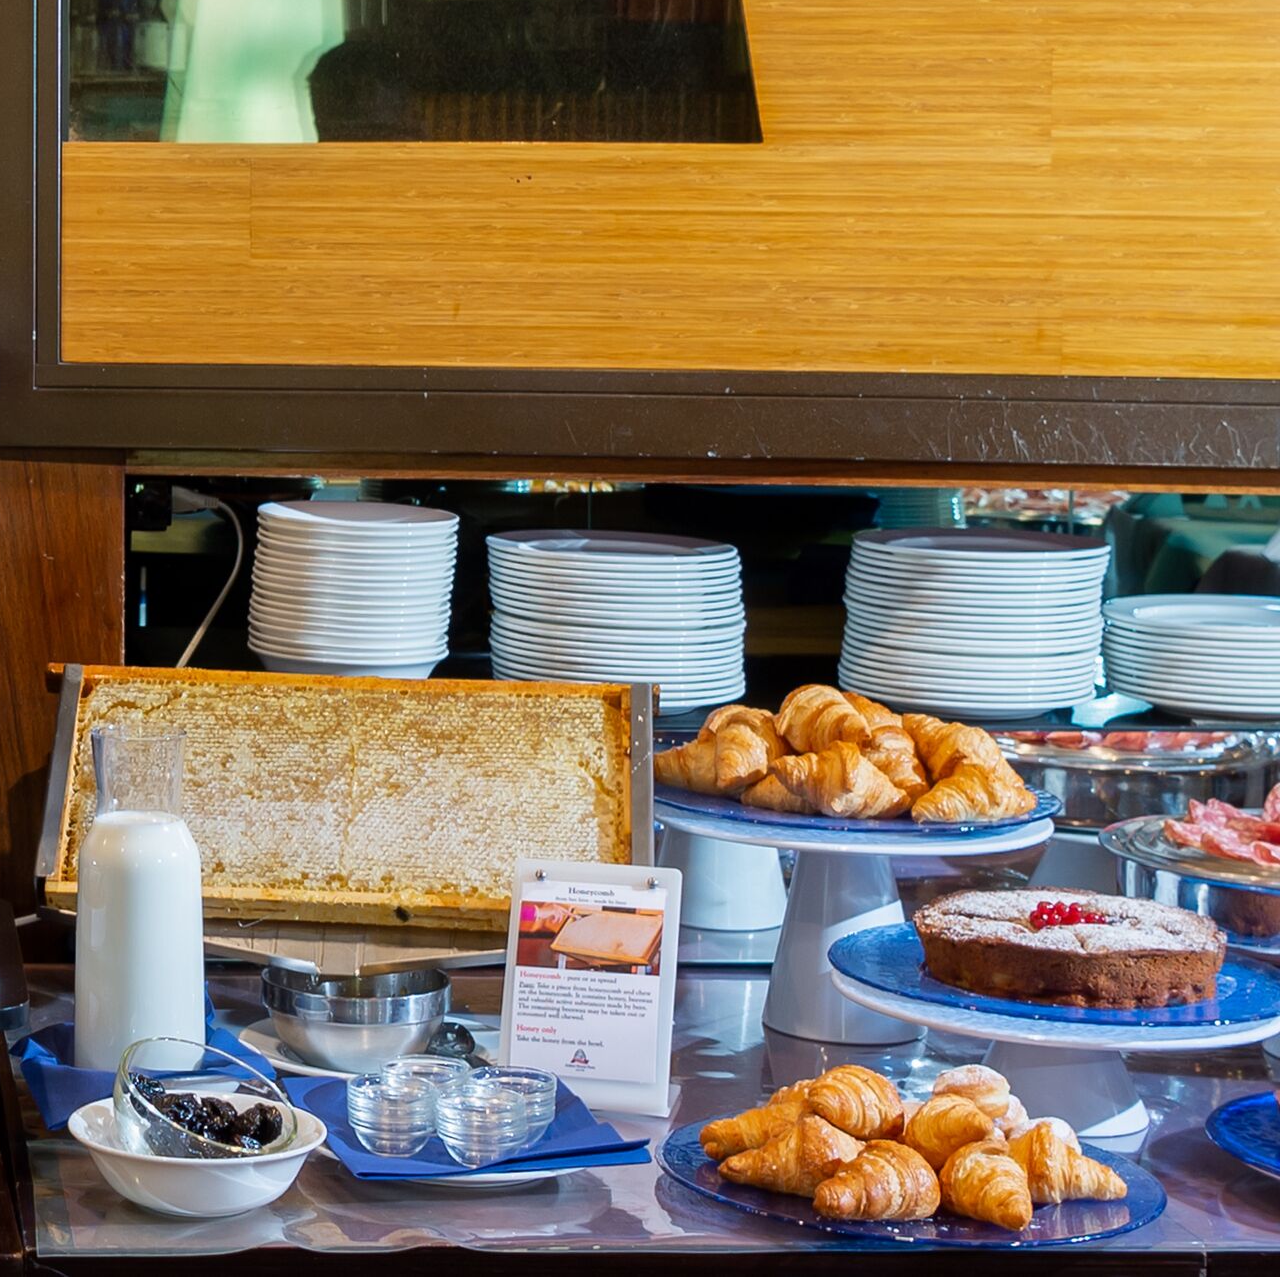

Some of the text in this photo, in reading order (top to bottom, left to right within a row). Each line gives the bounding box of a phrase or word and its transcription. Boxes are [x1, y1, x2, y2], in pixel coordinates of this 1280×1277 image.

[568, 887, 615, 897] Honeycomb
[520, 971, 561, 979] Honeycomb
[516, 1024, 540, 1033] Honey
